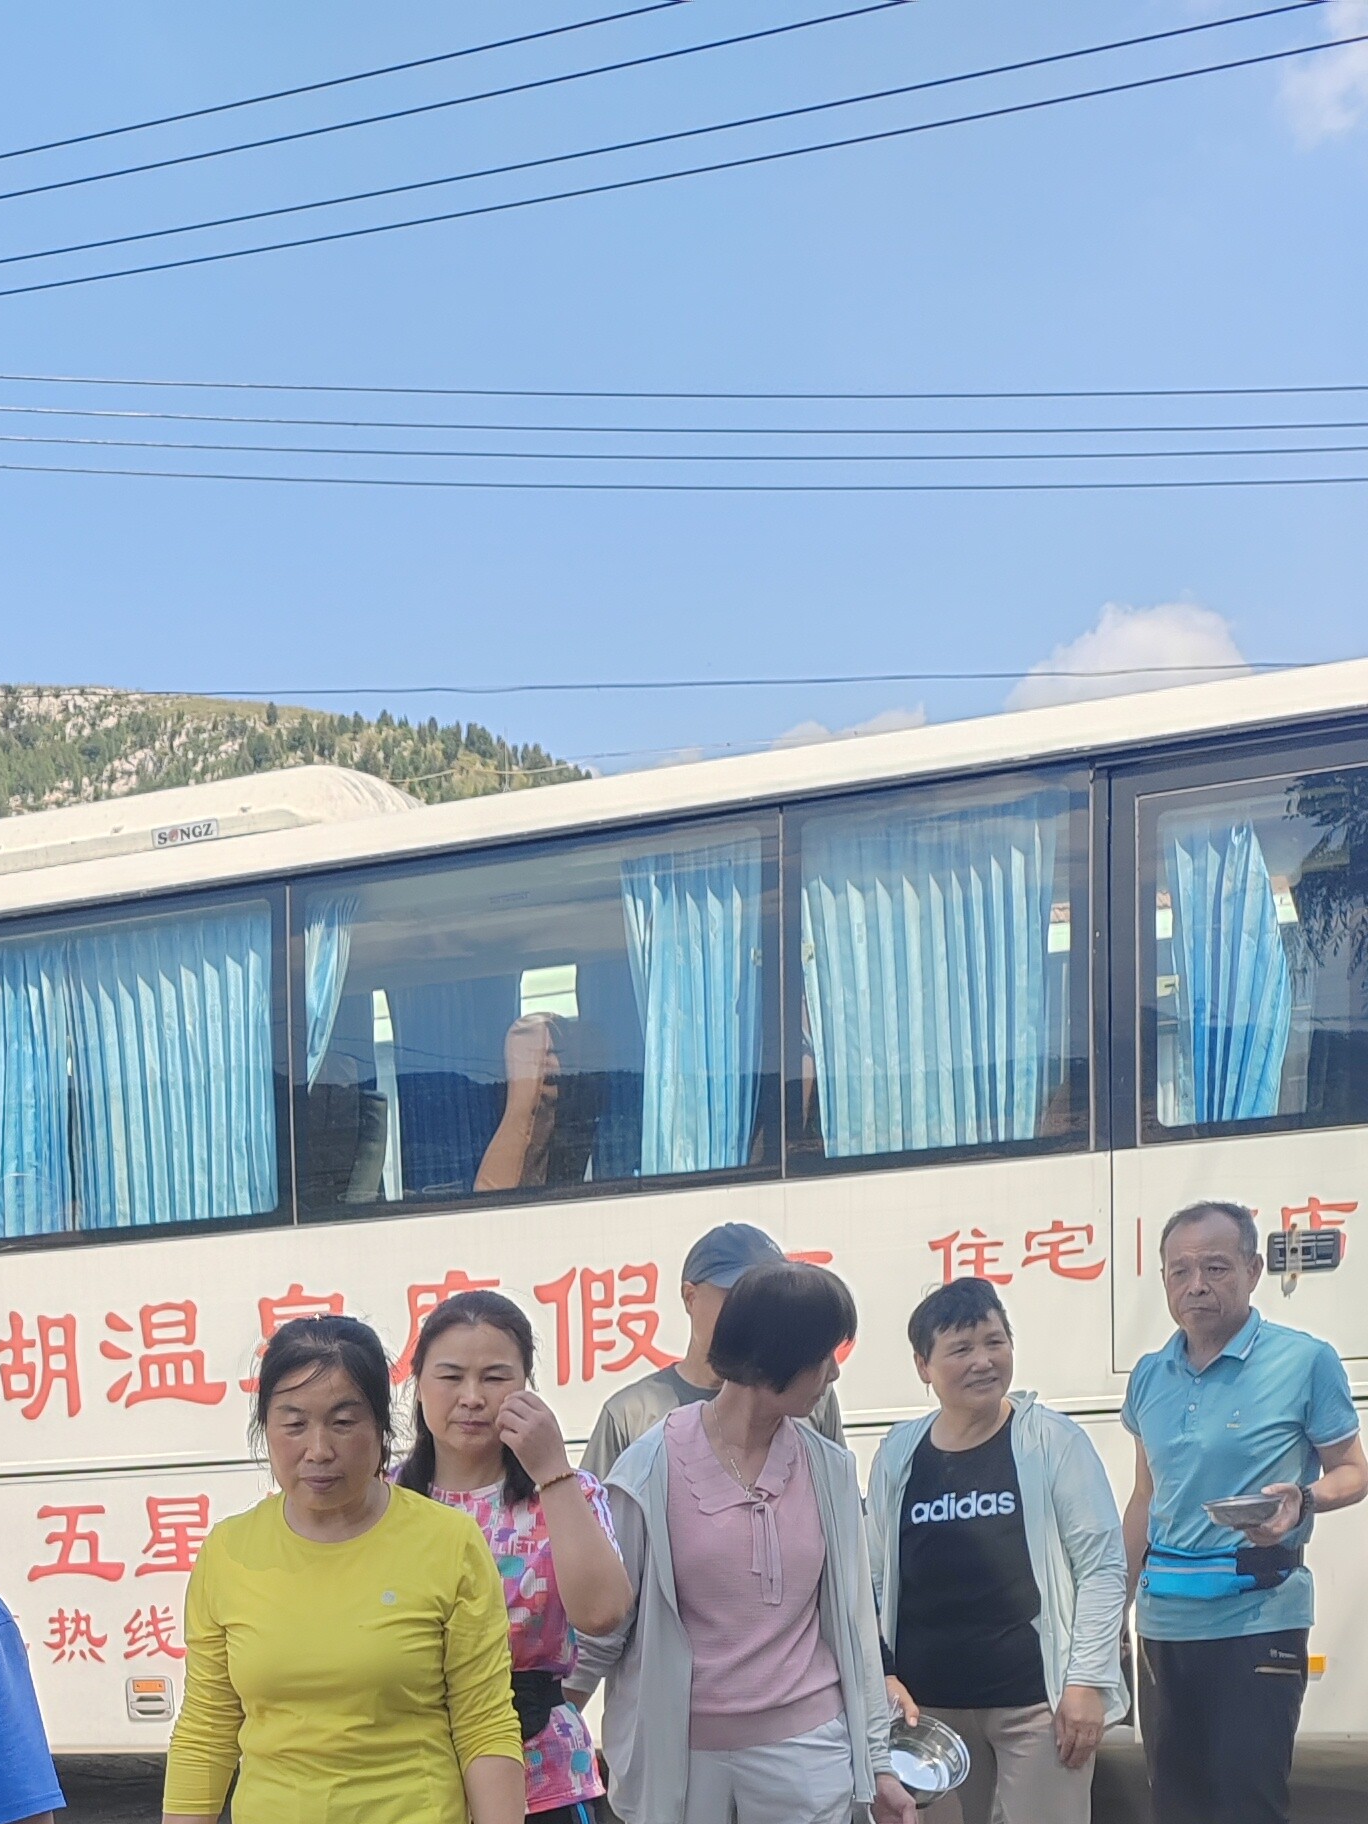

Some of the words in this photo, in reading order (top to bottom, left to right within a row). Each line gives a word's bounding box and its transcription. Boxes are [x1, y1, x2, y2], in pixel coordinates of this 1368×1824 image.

[157, 823, 213, 845] SONGZ
[928, 1220, 1106, 1286] 住宅
[911, 1490, 1016, 1525] adidas
[12, 1604, 188, 1664] 热线
